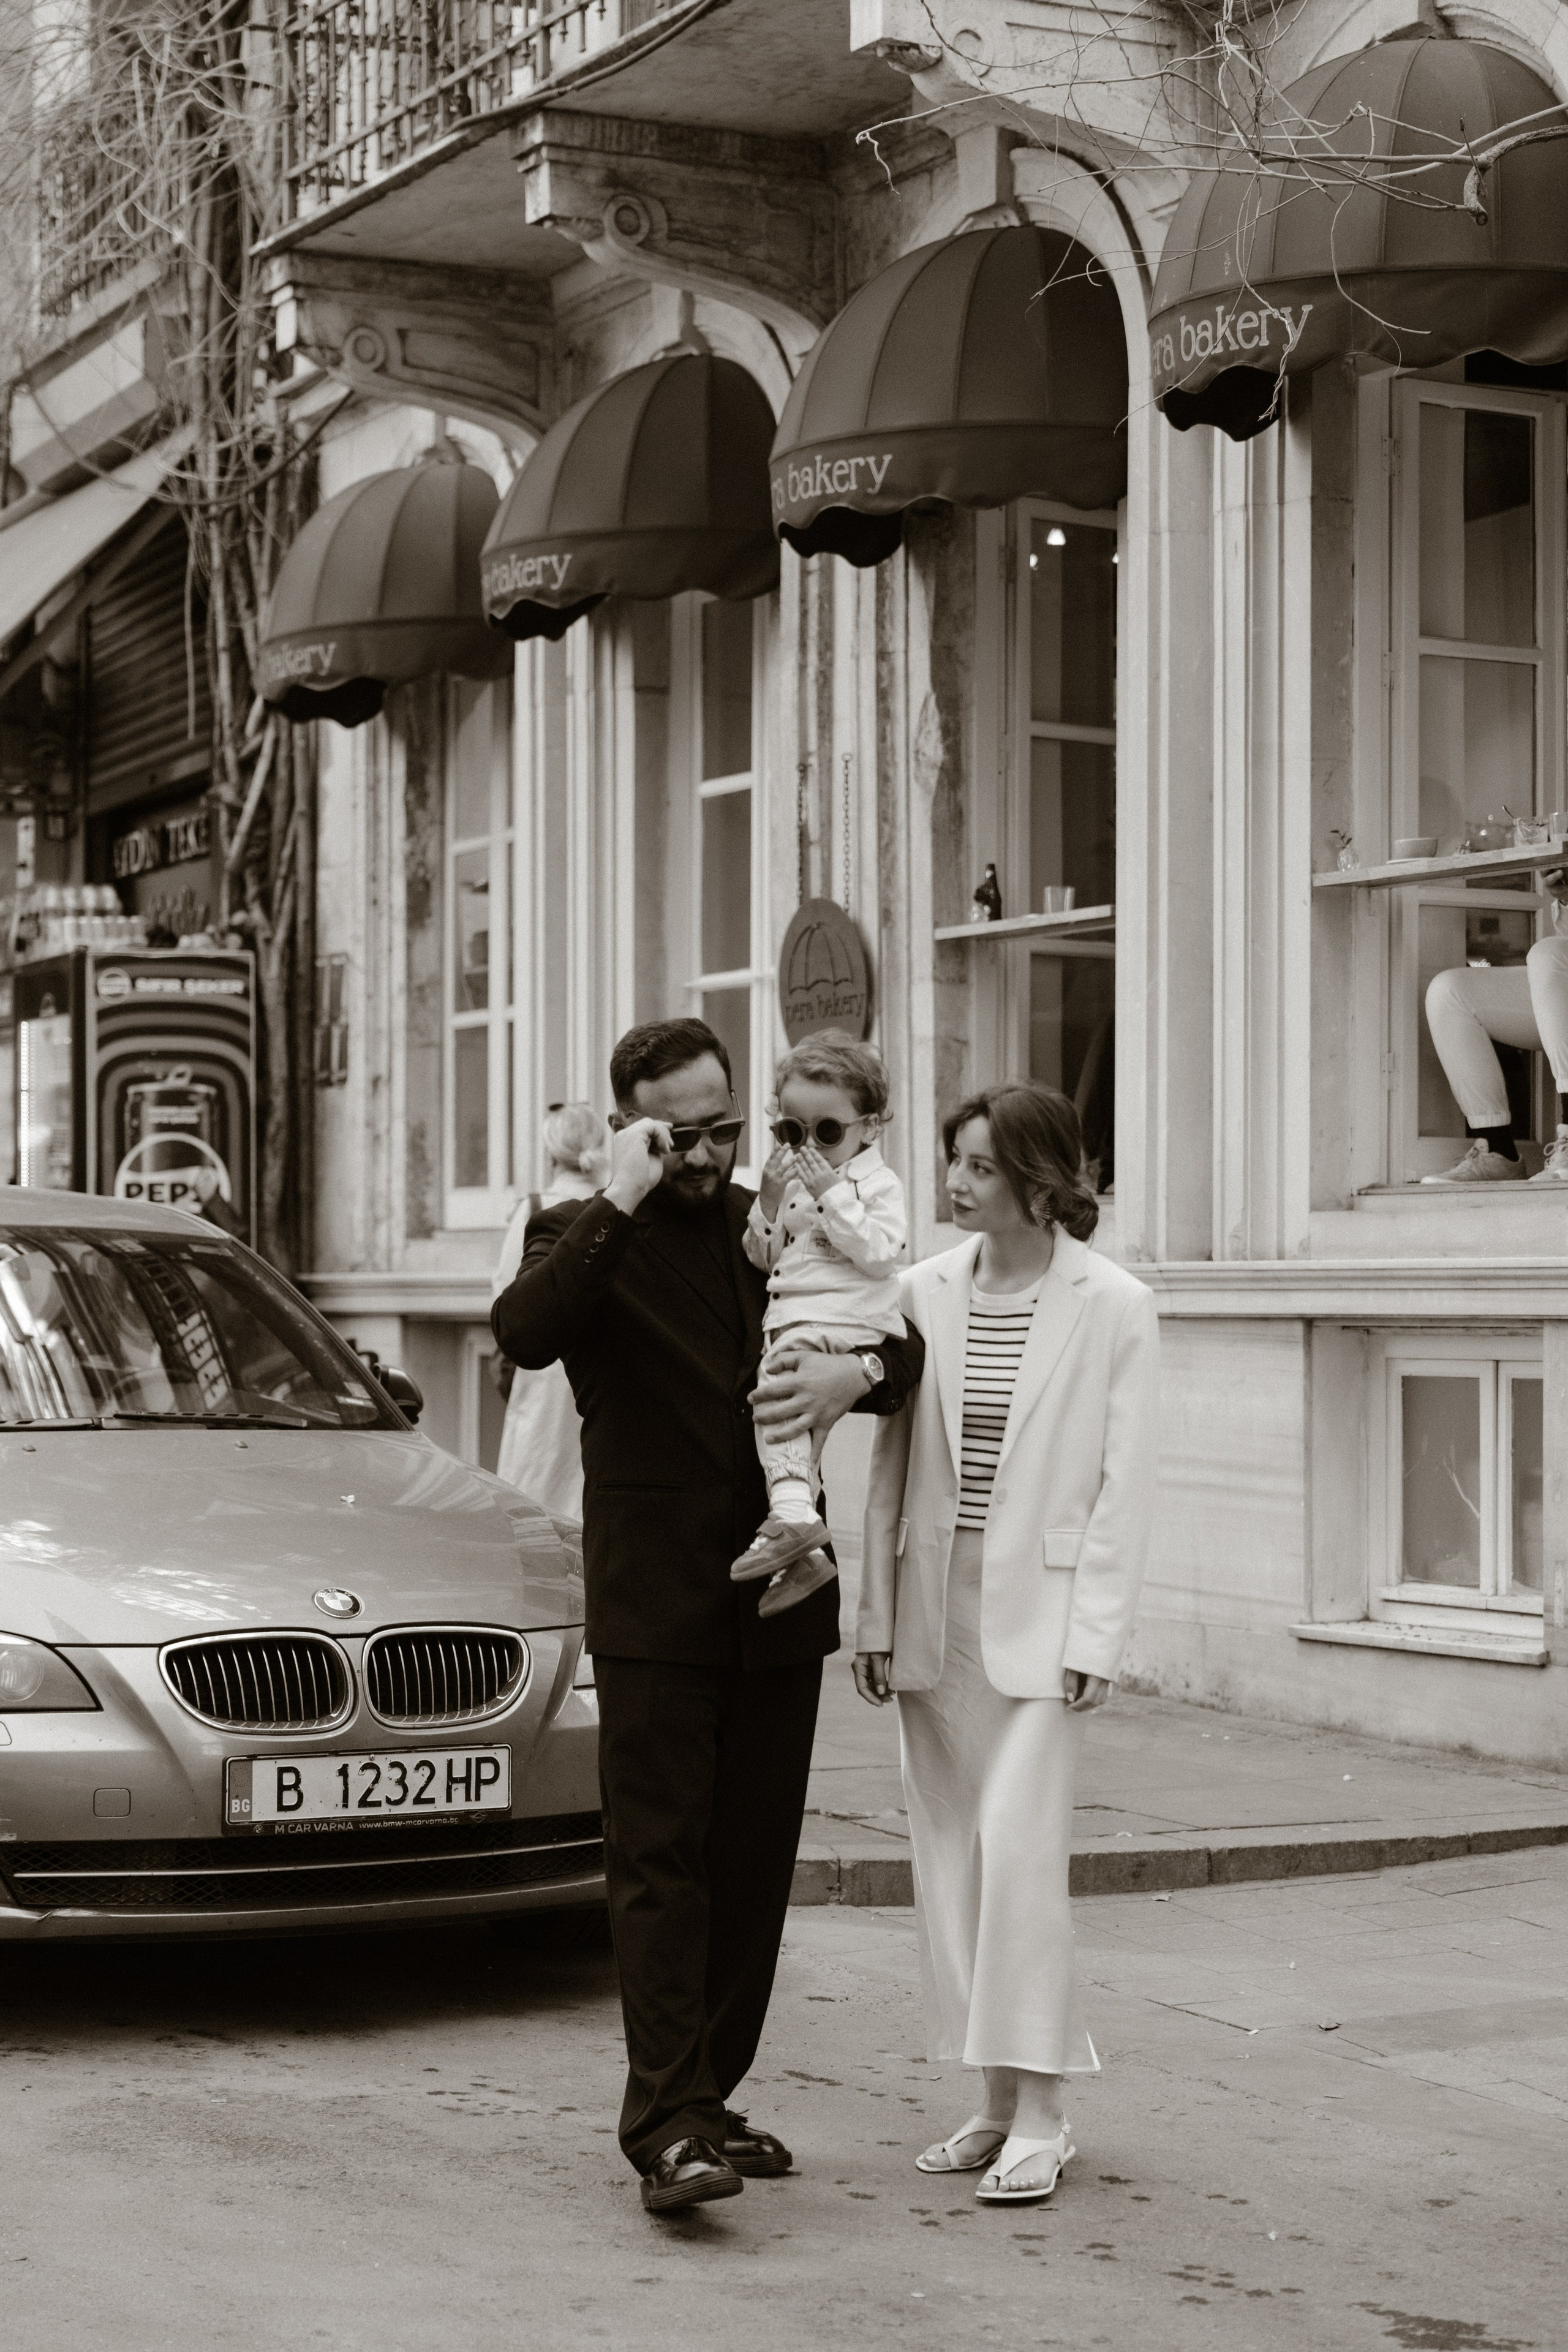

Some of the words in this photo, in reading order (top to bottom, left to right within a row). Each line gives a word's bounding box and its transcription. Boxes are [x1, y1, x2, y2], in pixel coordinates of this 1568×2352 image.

[1179, 304, 1313, 362] bakery
[787, 453, 893, 502] bakery
[816, 992, 864, 1018] bakery
[124, 1182, 202, 1204] PEP
[317, 1588, 353, 1598] BMW
[277, 1766, 304, 1812] B
[231, 1799, 251, 1814] BG
[275, 1825, 285, 1834] M
[287, 1824, 311, 1834] CAR
[313, 1822, 354, 1833] VARNA
